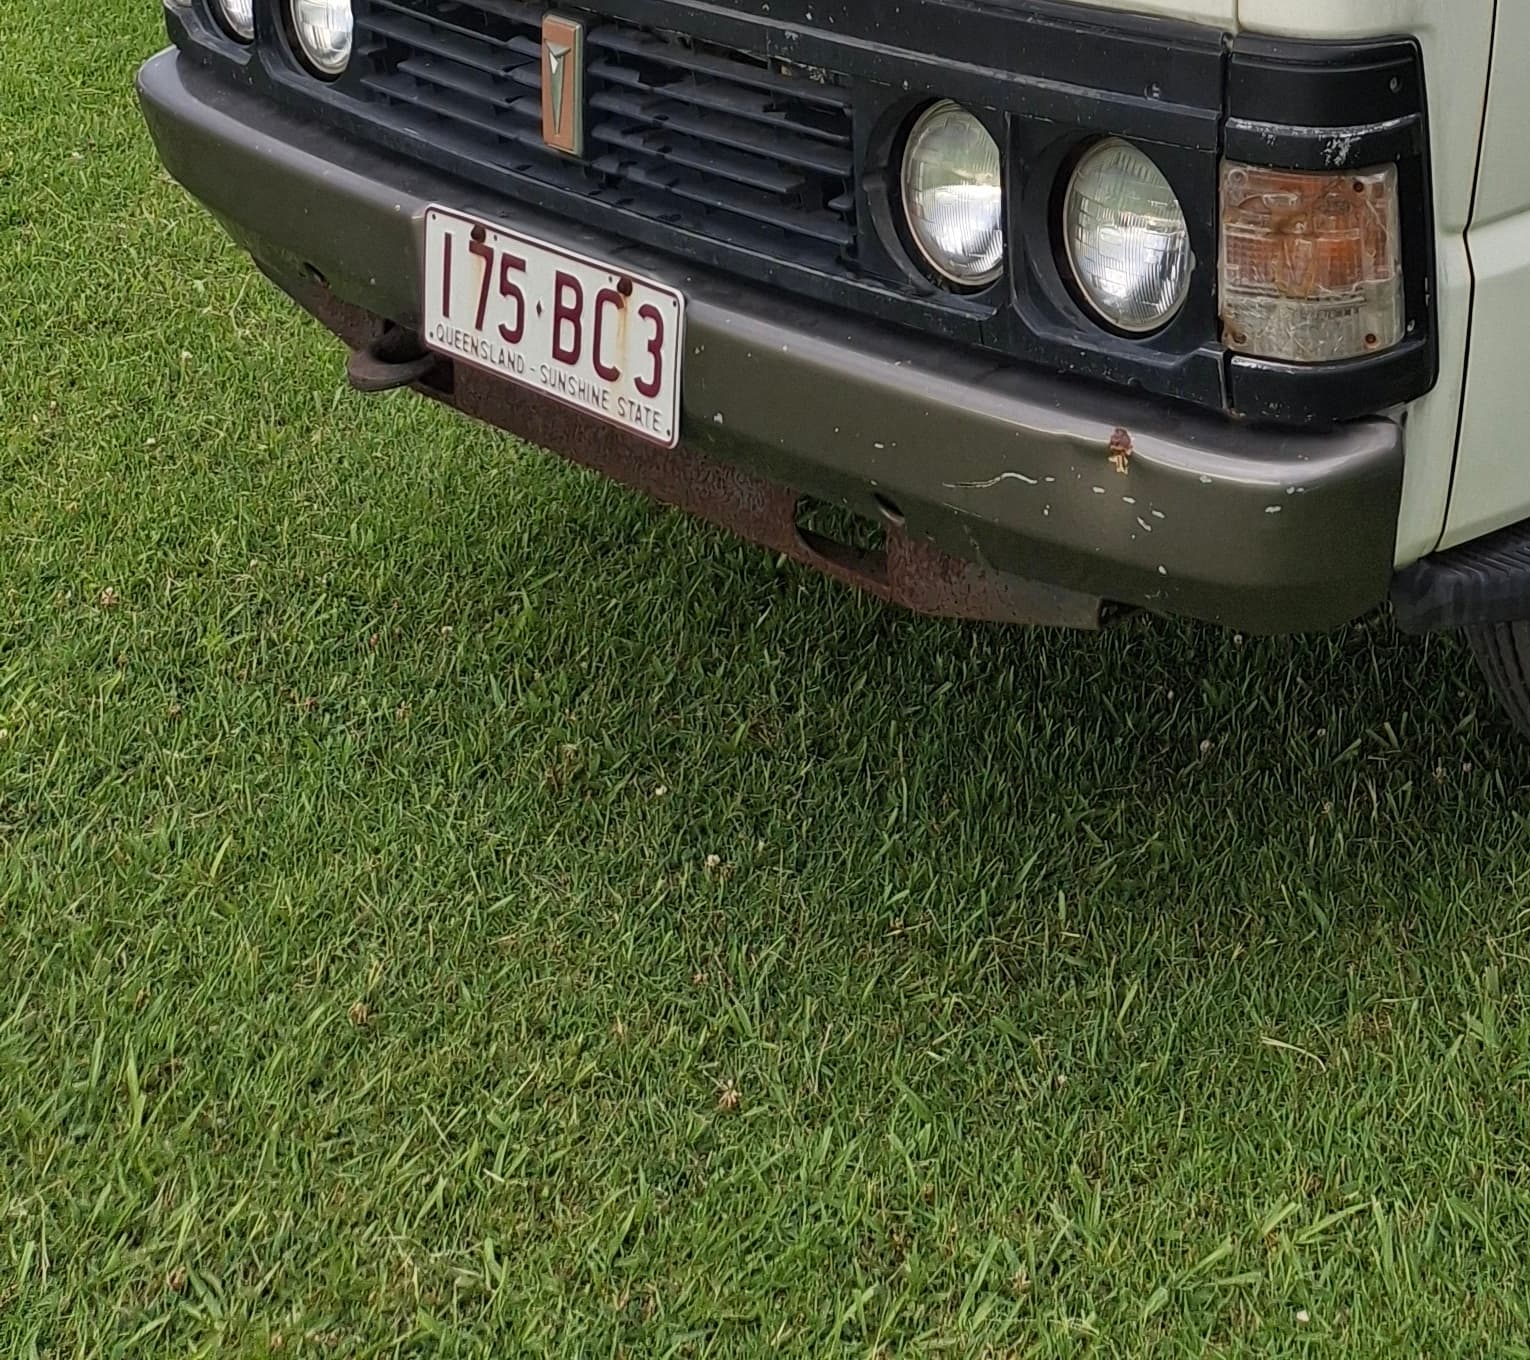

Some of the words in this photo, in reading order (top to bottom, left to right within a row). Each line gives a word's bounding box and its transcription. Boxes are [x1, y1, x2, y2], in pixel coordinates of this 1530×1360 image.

[435, 324, 526, 375] QUEENSLAND
[538, 364, 610, 412] SUNSHINE
[616, 394, 663, 433] STATE
